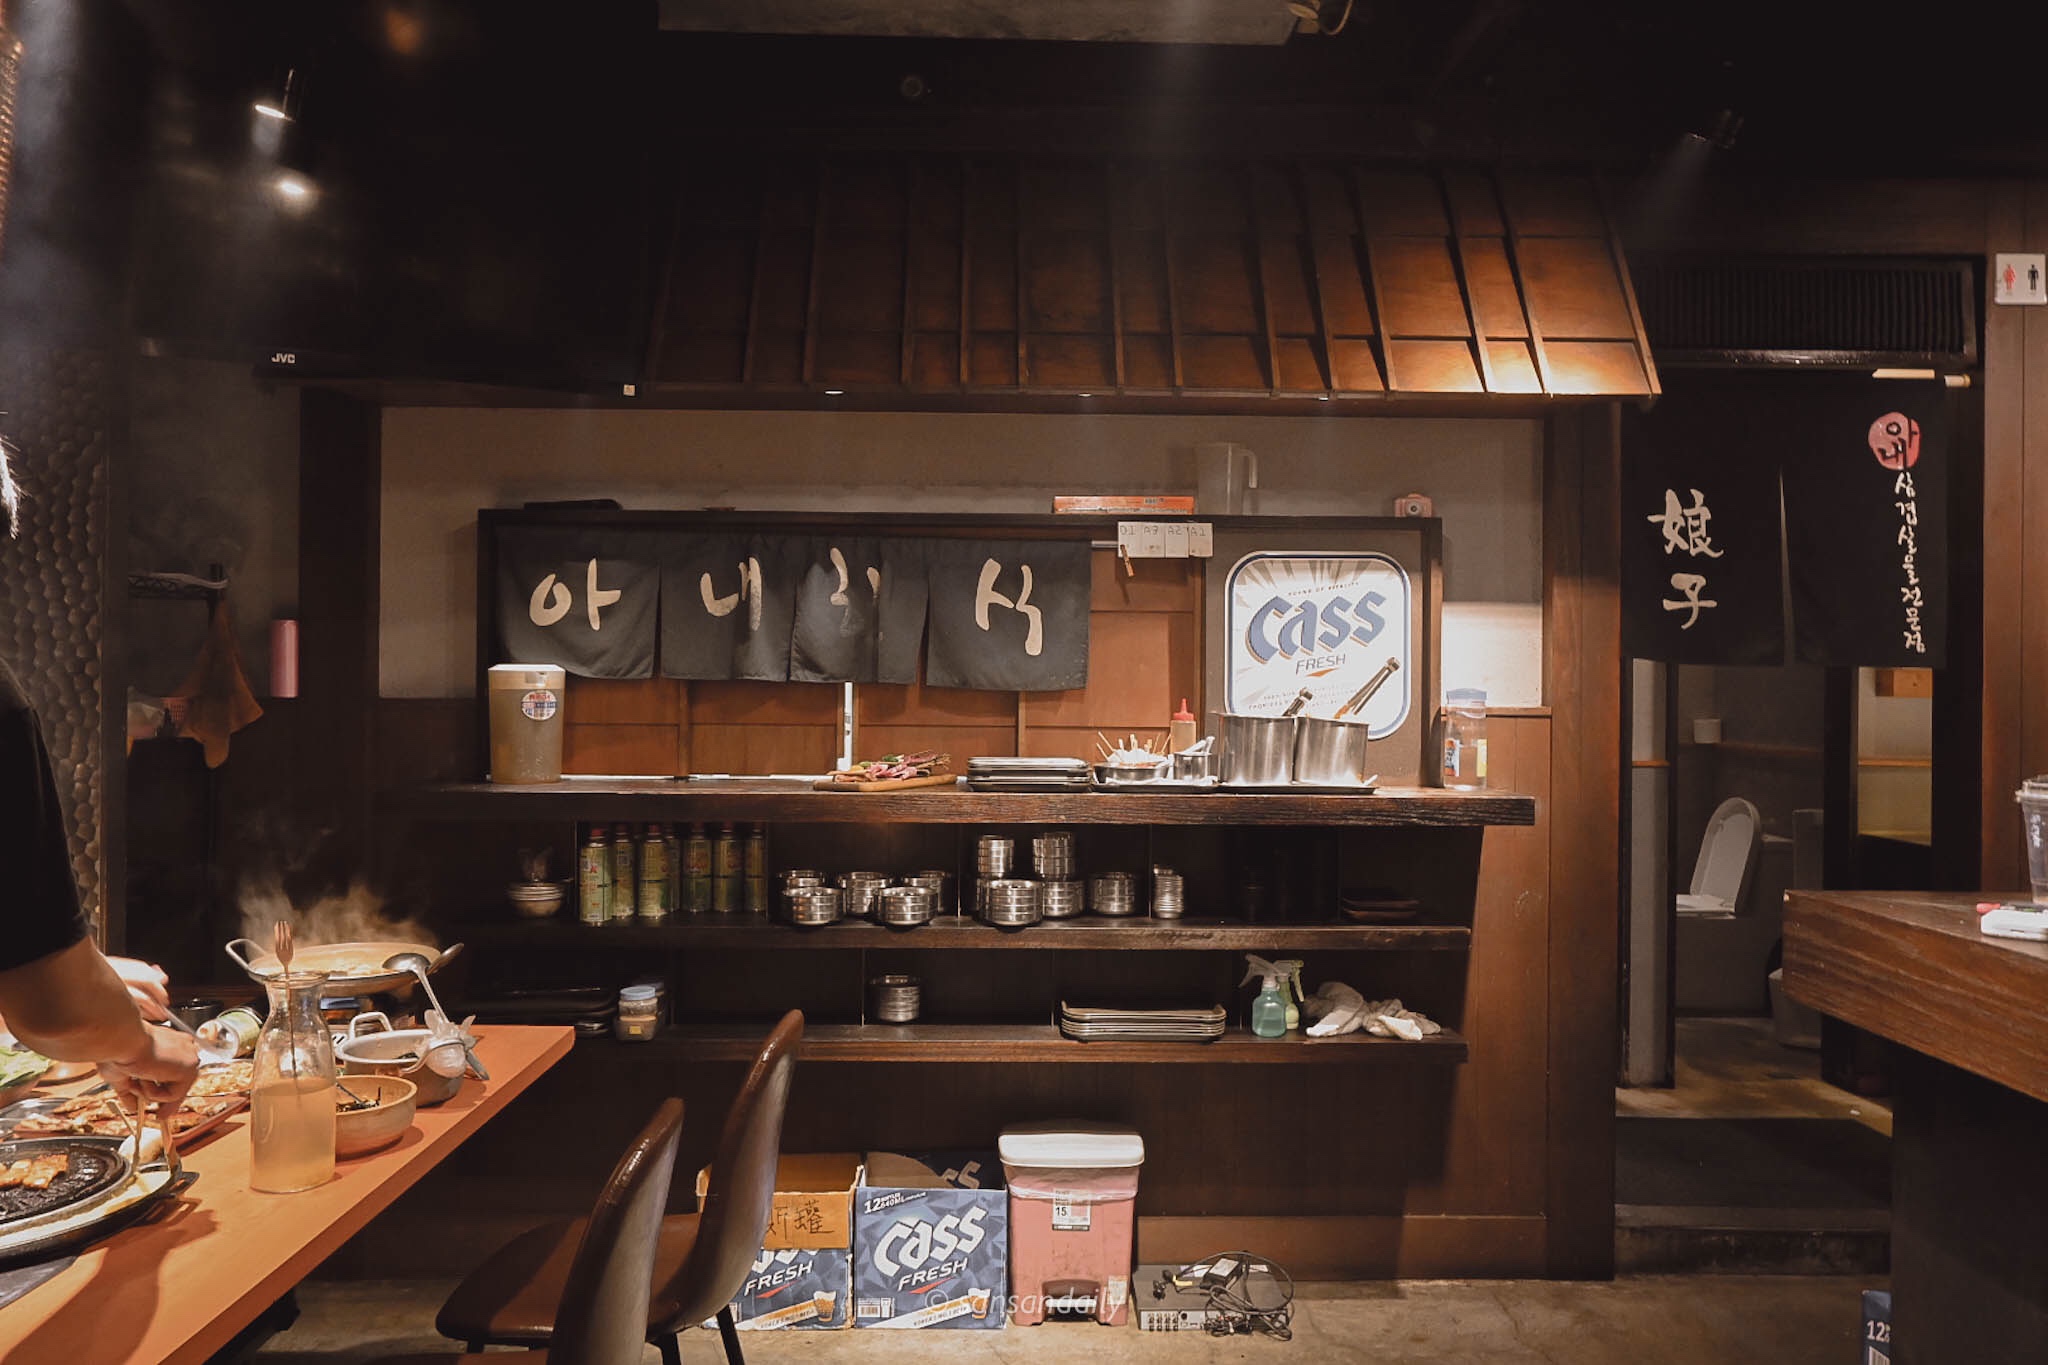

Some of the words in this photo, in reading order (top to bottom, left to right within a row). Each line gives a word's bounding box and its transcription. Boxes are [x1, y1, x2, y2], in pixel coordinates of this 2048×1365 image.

[271, 353, 296, 364] JVC
[1647, 488, 1724, 630] 娘子
[1296, 653, 1346, 675] FRESH
[1056, 1206, 1068, 1217] 15
[744, 1260, 813, 1297] FRESH
[898, 1257, 968, 1292] FRESH
